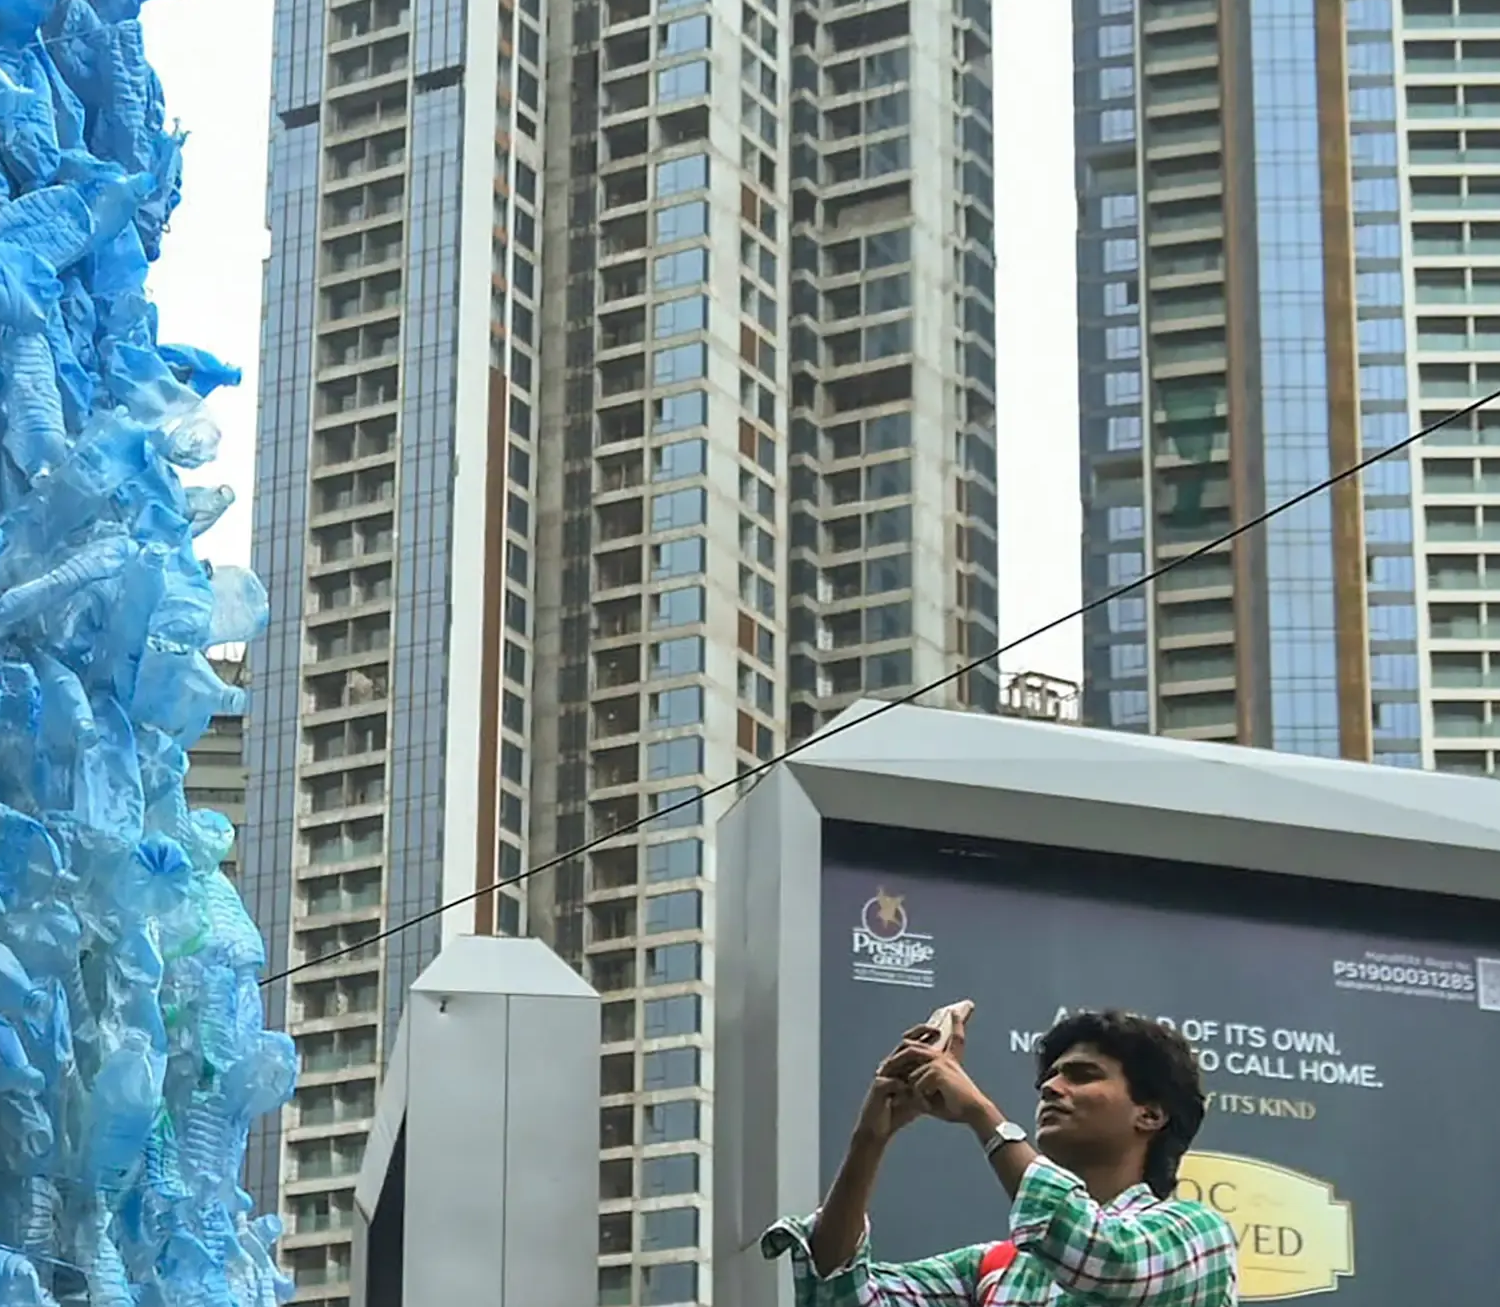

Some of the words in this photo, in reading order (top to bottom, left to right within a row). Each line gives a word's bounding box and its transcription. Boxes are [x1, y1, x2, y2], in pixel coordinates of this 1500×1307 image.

[852, 932, 935, 963] Prestige
[1182, 1019, 1219, 1042] OF
[1225, 1023, 1266, 1048] ITS
[1272, 1028, 1341, 1055] OWN.
[1225, 1051, 1293, 1080] CALL
[1301, 1059, 1384, 1089] HOME.
[1220, 1094, 1255, 1114] ITS
[1260, 1098, 1316, 1120] KIND
[1229, 1222, 1304, 1257] VED
